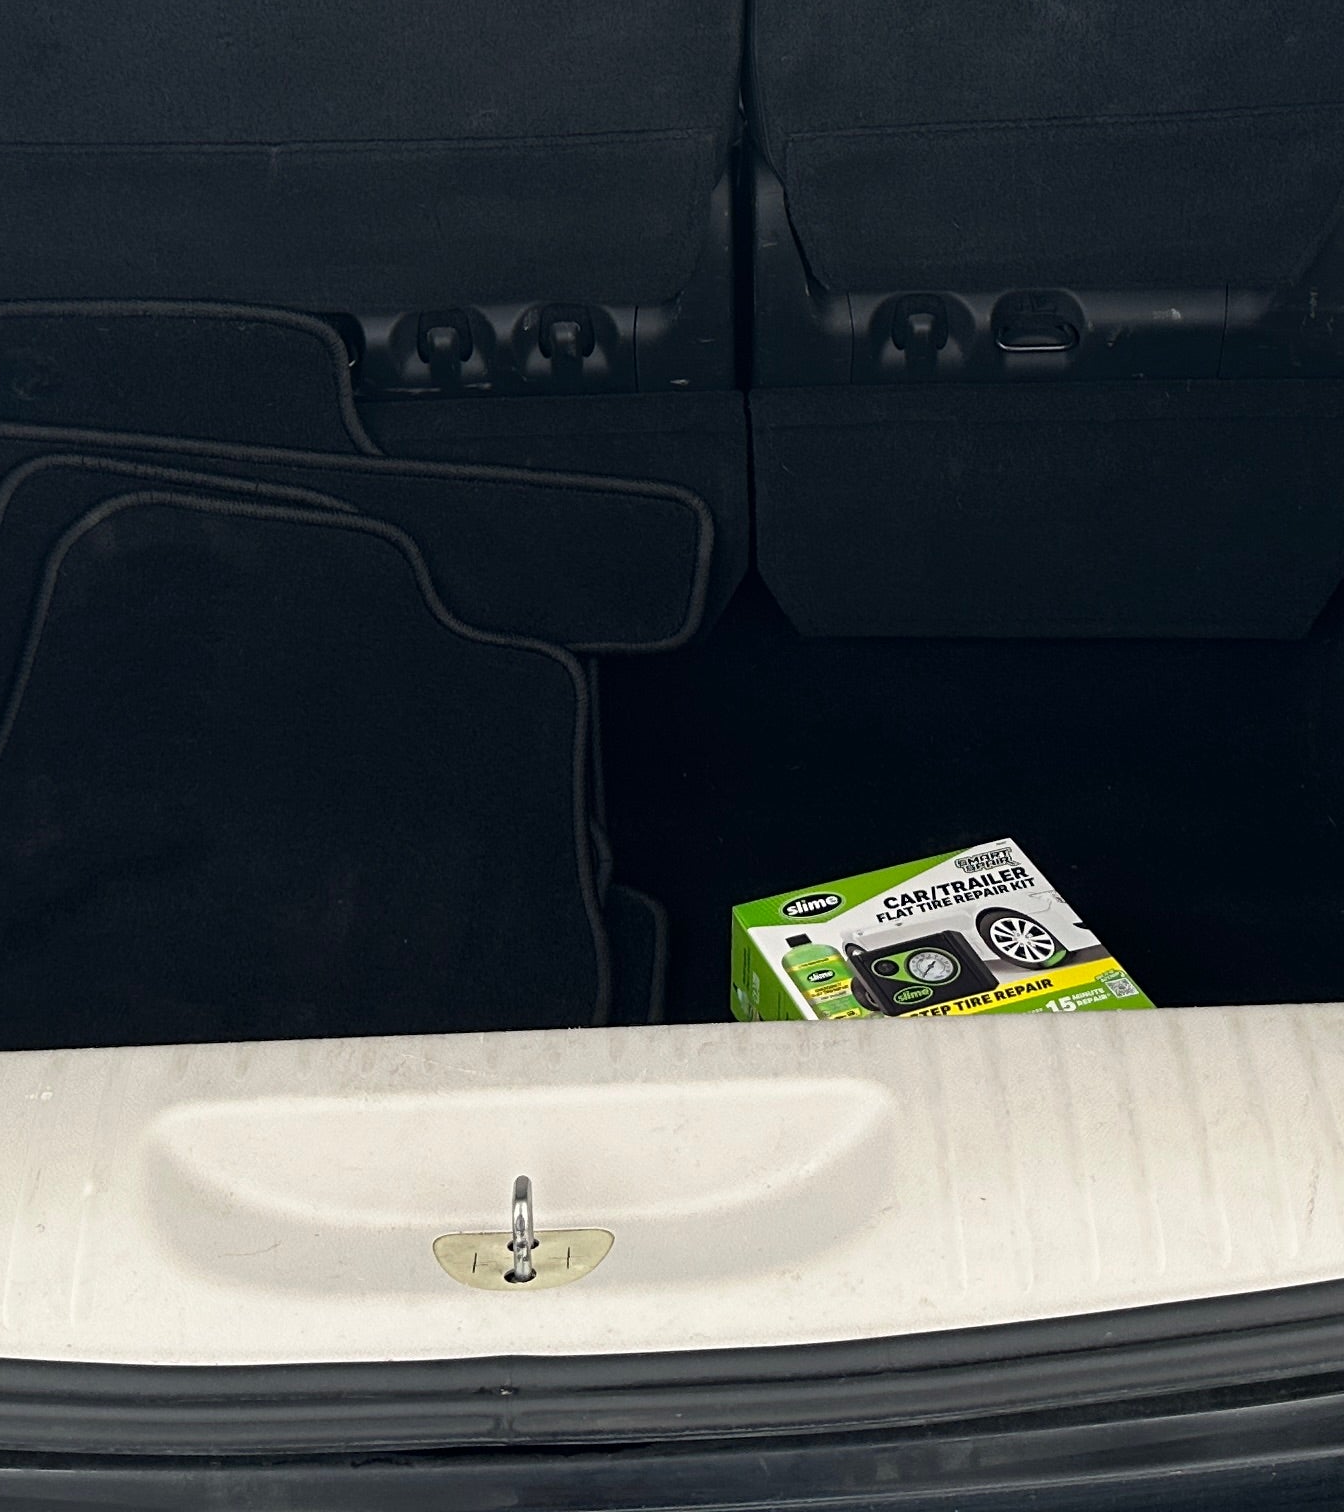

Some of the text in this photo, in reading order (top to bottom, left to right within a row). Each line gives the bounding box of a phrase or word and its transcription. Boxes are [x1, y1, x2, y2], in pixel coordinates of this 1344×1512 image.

[883, 867, 1030, 909] CAR/TRAILER
[787, 895, 839, 916] slime
[876, 877, 1035, 923] FLAT TIRE REPAIR KIT
[897, 988, 930, 1002] slime
[910, 978, 1054, 1016] TEP TIRE REPAIR
[1046, 996, 1077, 1013] 15
[1071, 988, 1106, 1001] MINUTE
